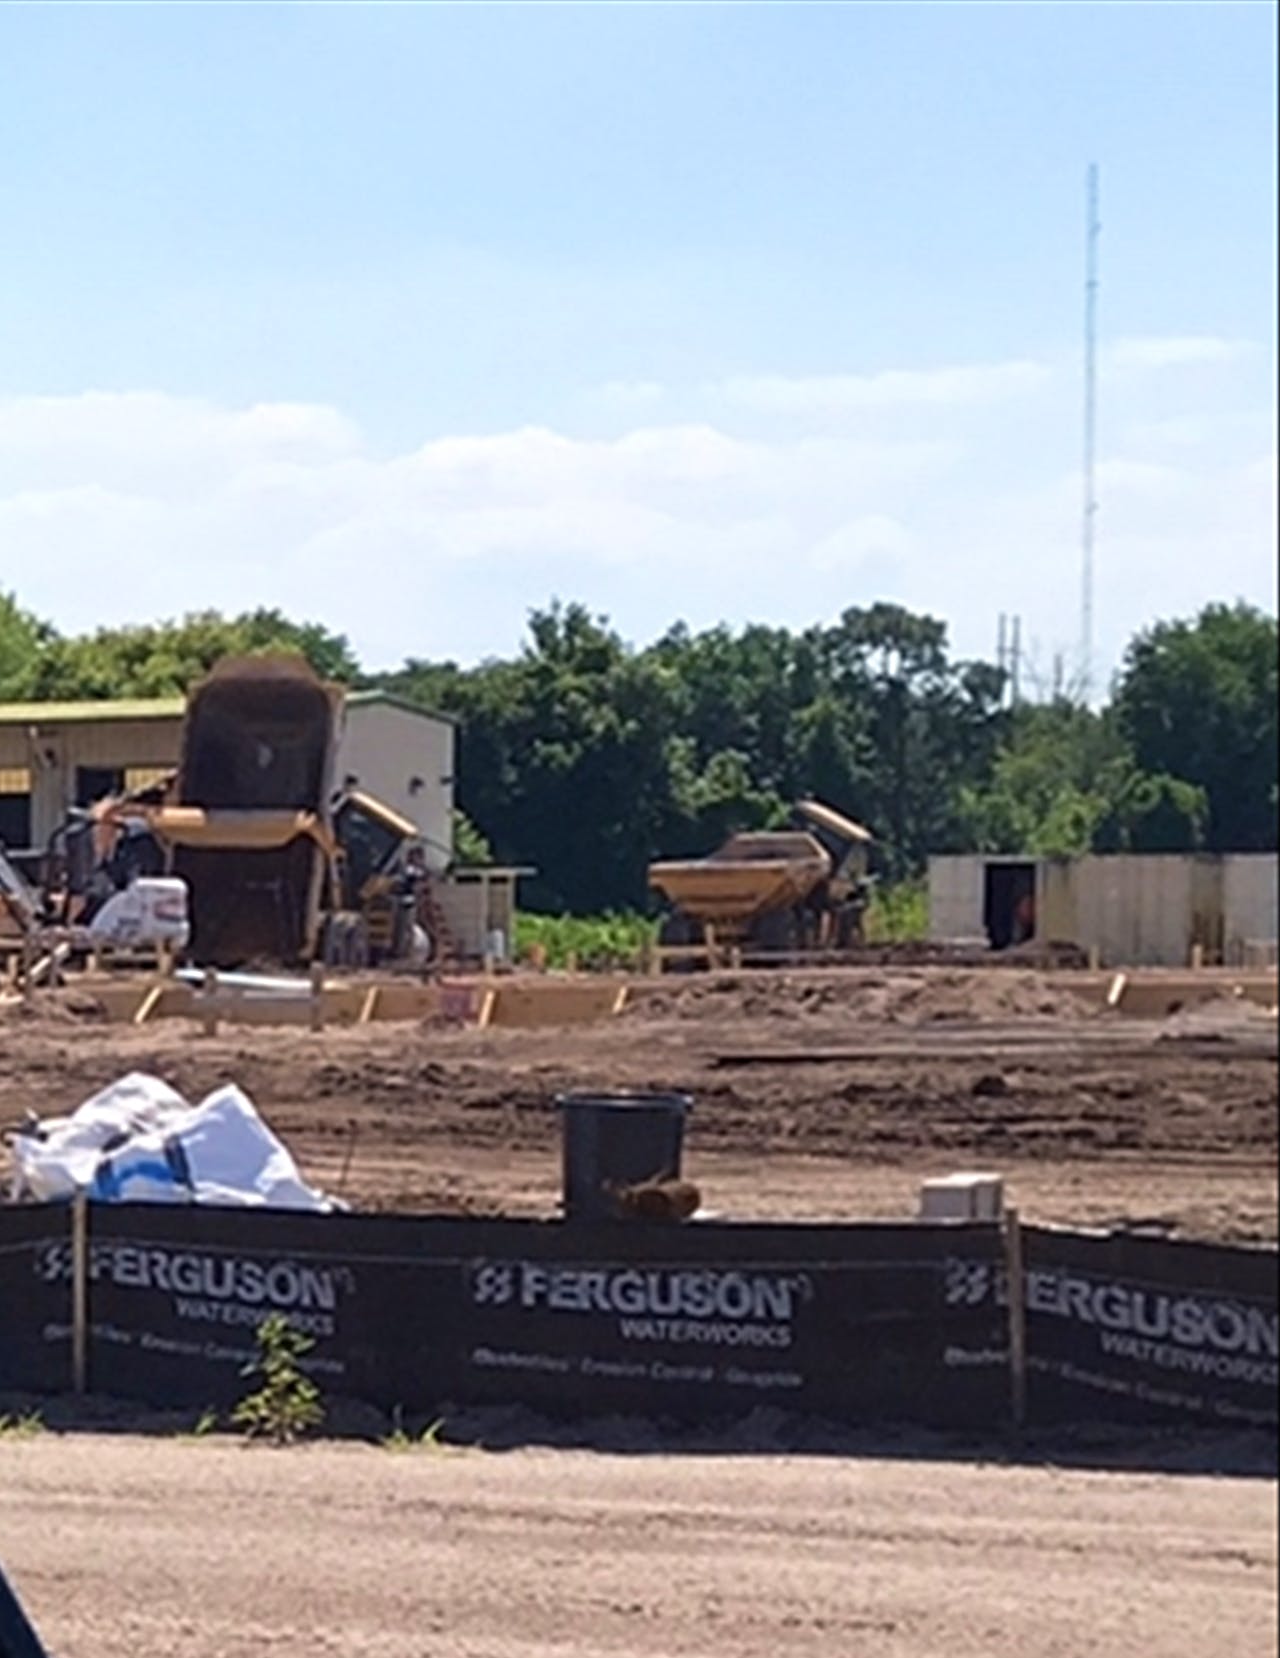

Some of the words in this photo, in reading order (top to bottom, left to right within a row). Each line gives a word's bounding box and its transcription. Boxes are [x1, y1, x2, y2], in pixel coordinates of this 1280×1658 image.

[88, 1247, 335, 1309] FERGUSON
[521, 1267, 792, 1320] FERGUSON
[620, 1318, 792, 1347] WATERWORKS
